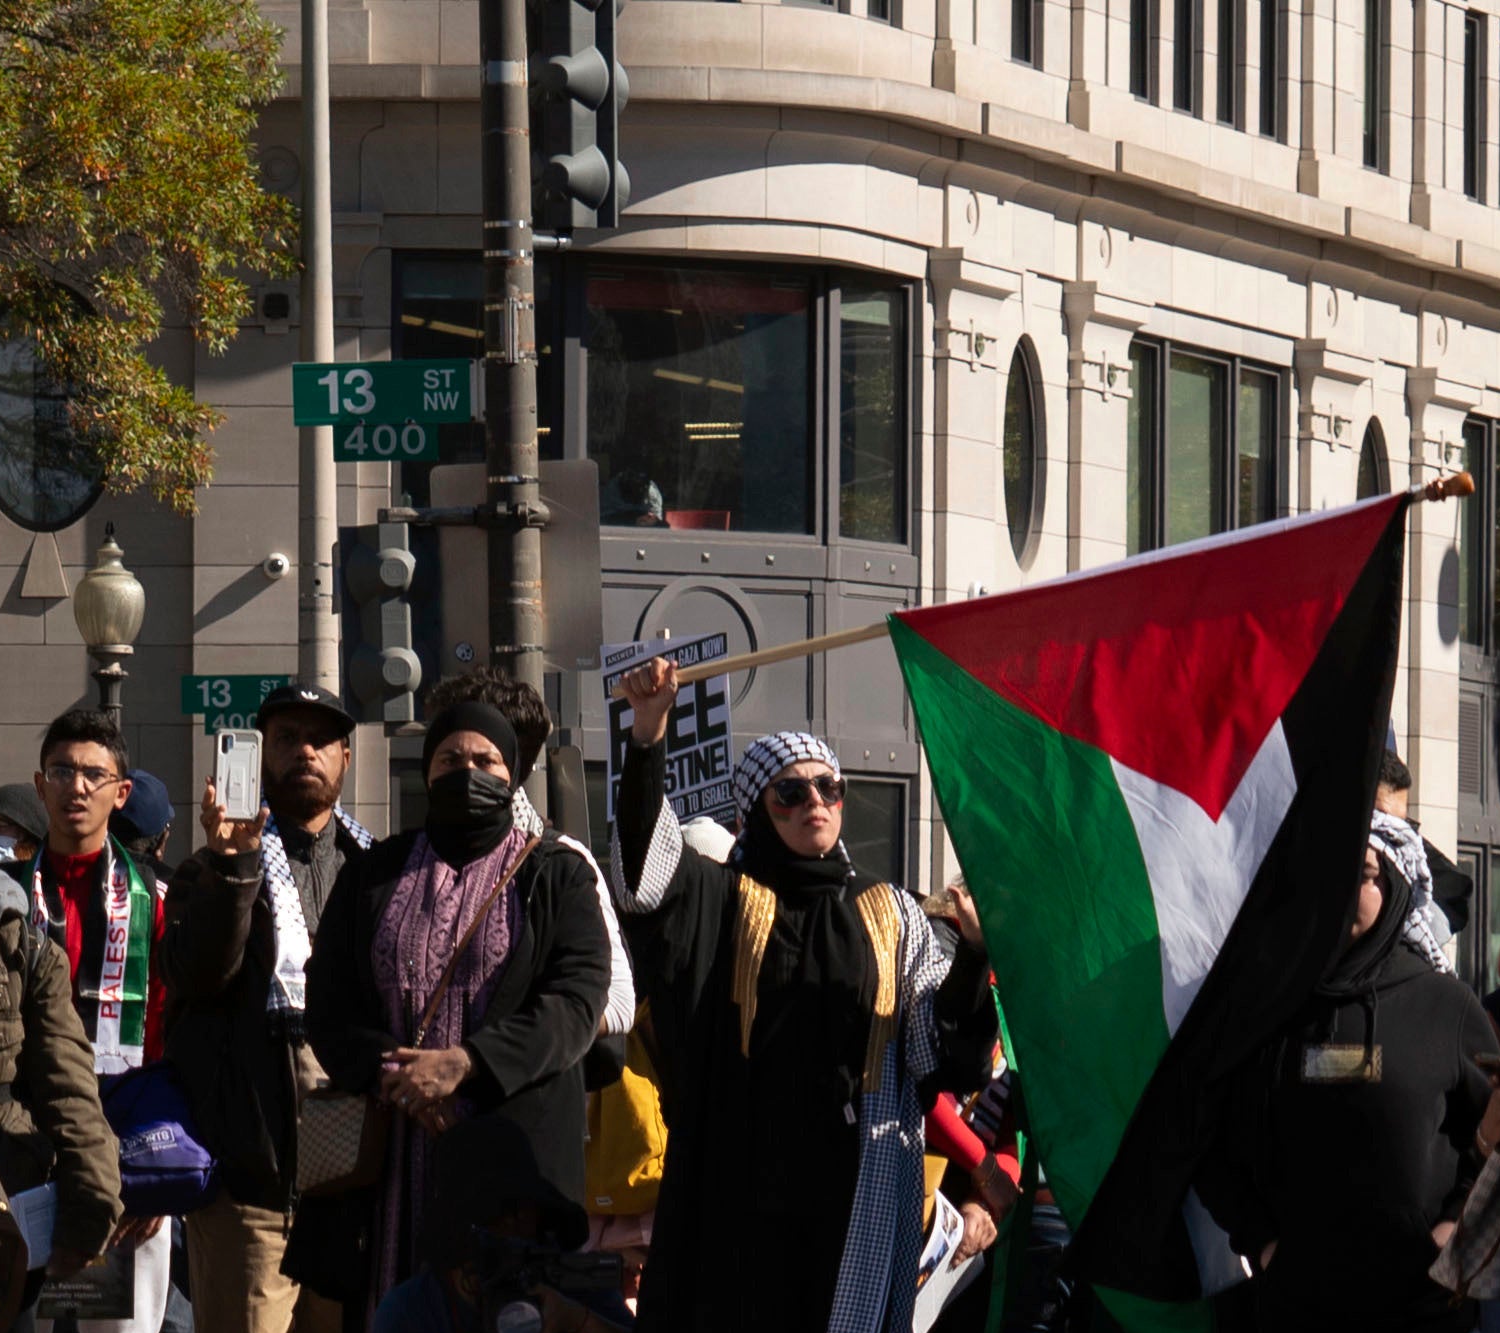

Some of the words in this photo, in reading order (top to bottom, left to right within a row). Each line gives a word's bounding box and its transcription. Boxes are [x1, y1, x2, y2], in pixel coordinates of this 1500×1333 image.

[317, 368, 376, 415] 13
[423, 369, 455, 389] ST
[423, 391, 459, 411] NW
[343, 424, 426, 456] 400
[678, 644, 699, 667] GAZA
[197, 680, 232, 707] 13
[260, 680, 280, 693] ST
[609, 678, 727, 779] FEE
[688, 792, 700, 814] TO
[701, 783, 733, 809] ISRAEL
[101, 873, 128, 1019] PALESTINE
